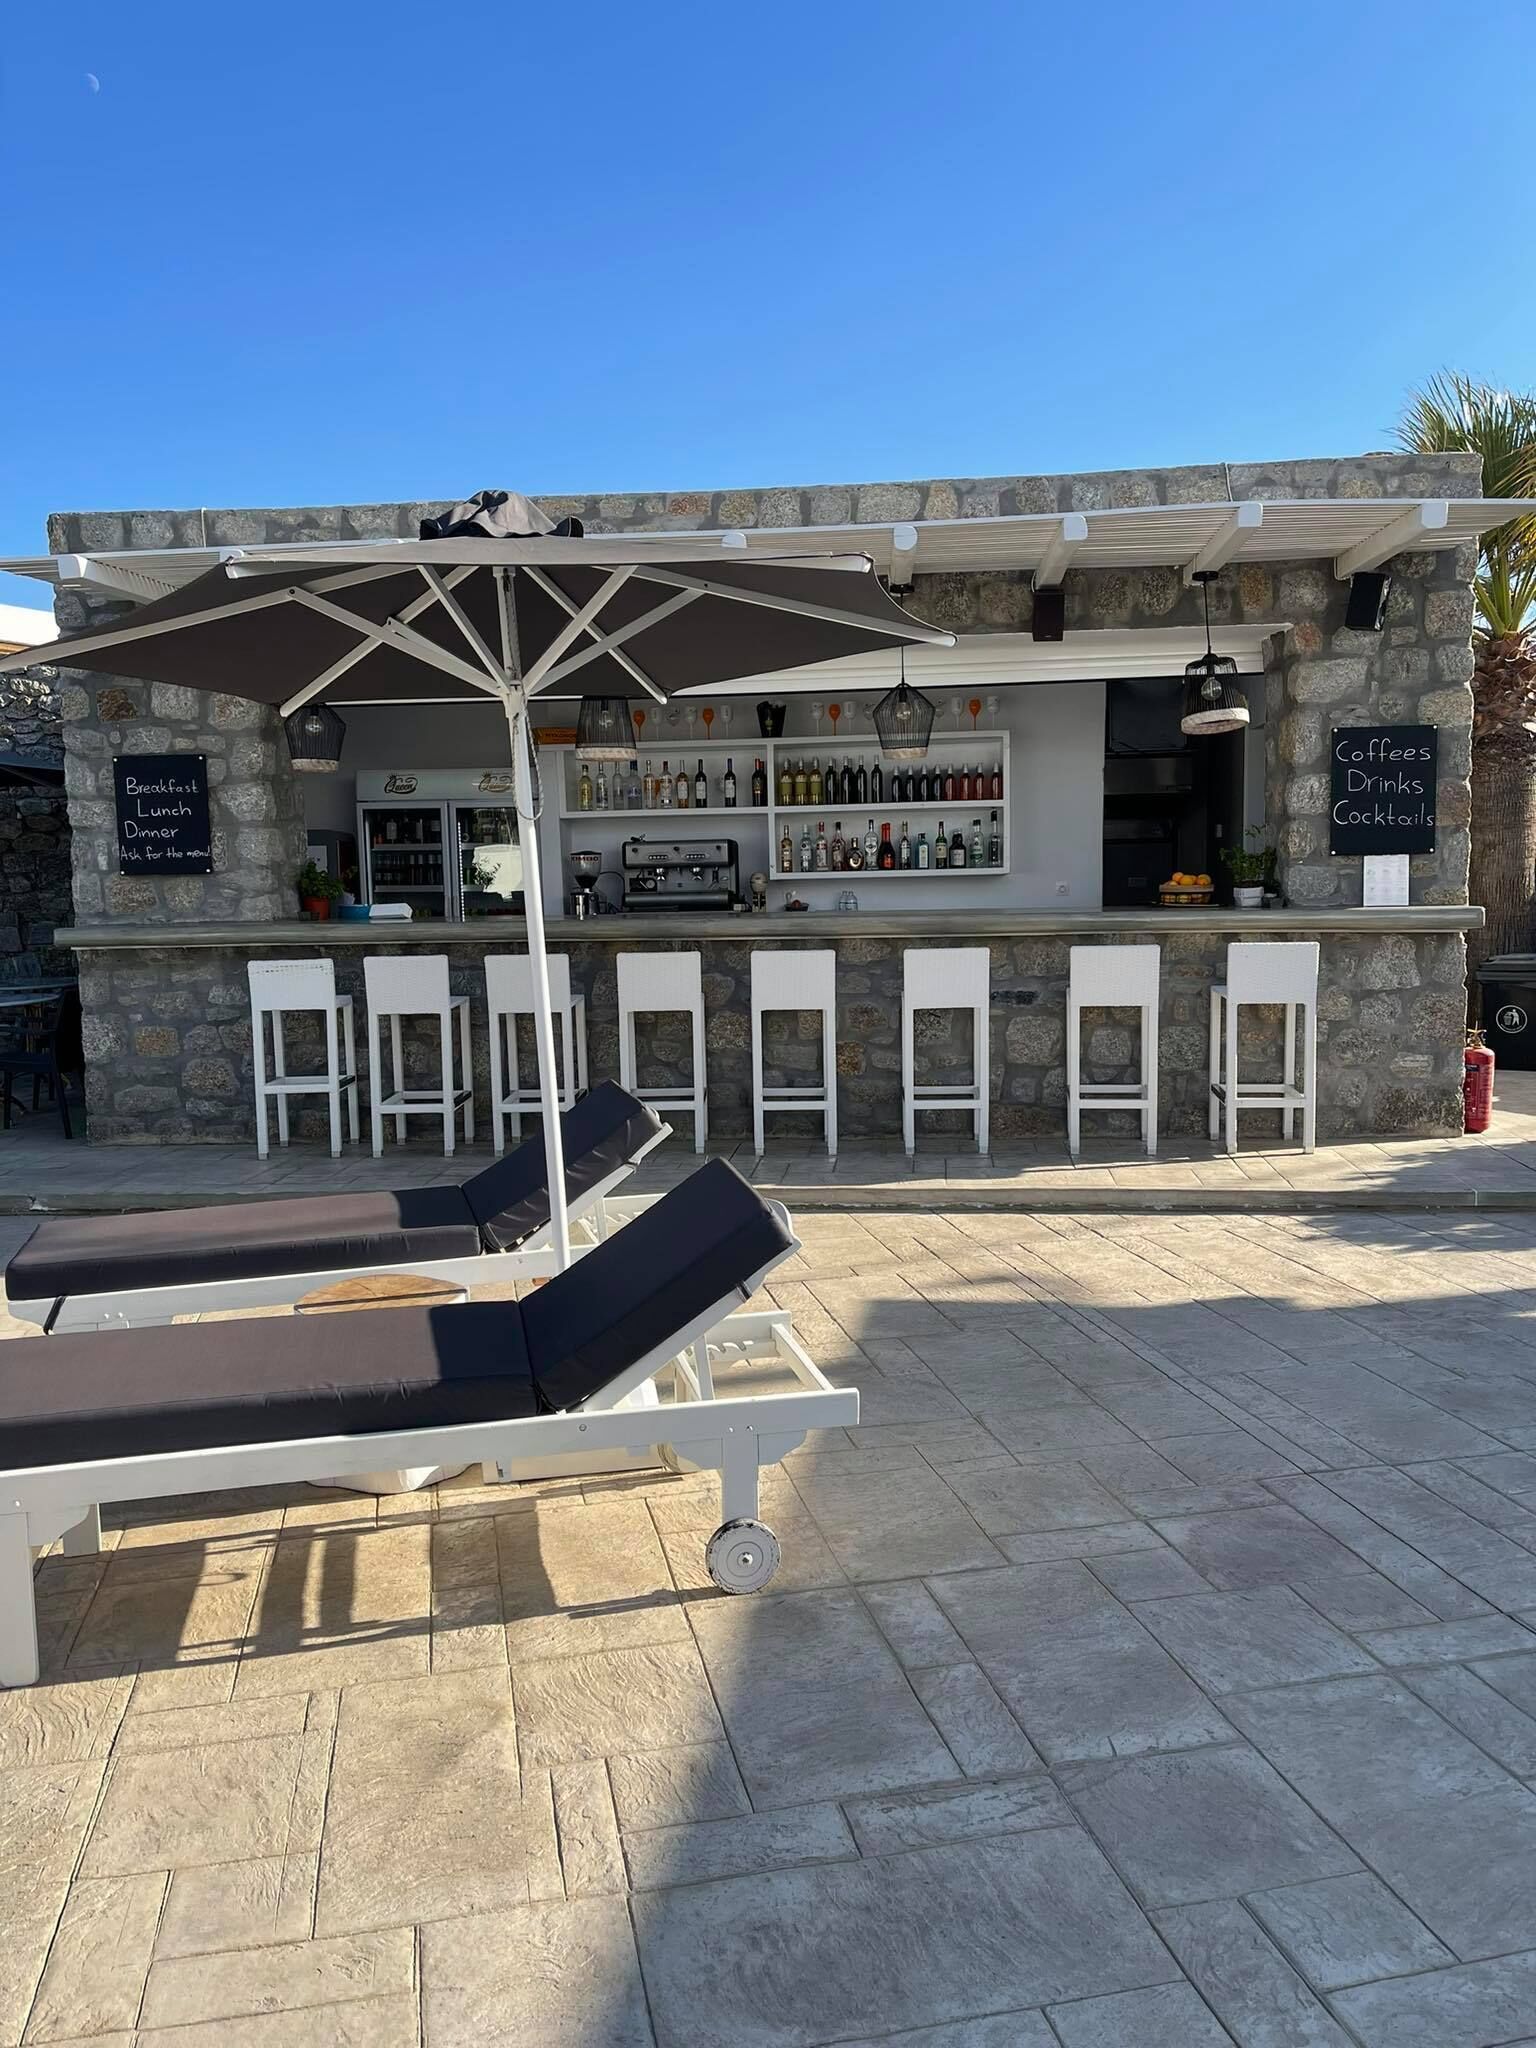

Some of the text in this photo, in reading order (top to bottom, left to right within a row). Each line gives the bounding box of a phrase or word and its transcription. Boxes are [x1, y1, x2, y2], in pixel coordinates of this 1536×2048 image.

[1337, 738, 1431, 762] Coffees
[126, 777, 199, 795] Breakfast
[1347, 769, 1424, 794] Drinks
[137, 799, 192, 817] Lunch
[1333, 800, 1435, 827] Cocktails
[124, 820, 179, 839] Dinner
[120, 845, 142, 861] Ask
[146, 847, 163, 861] for
[166, 846, 183, 858] the
